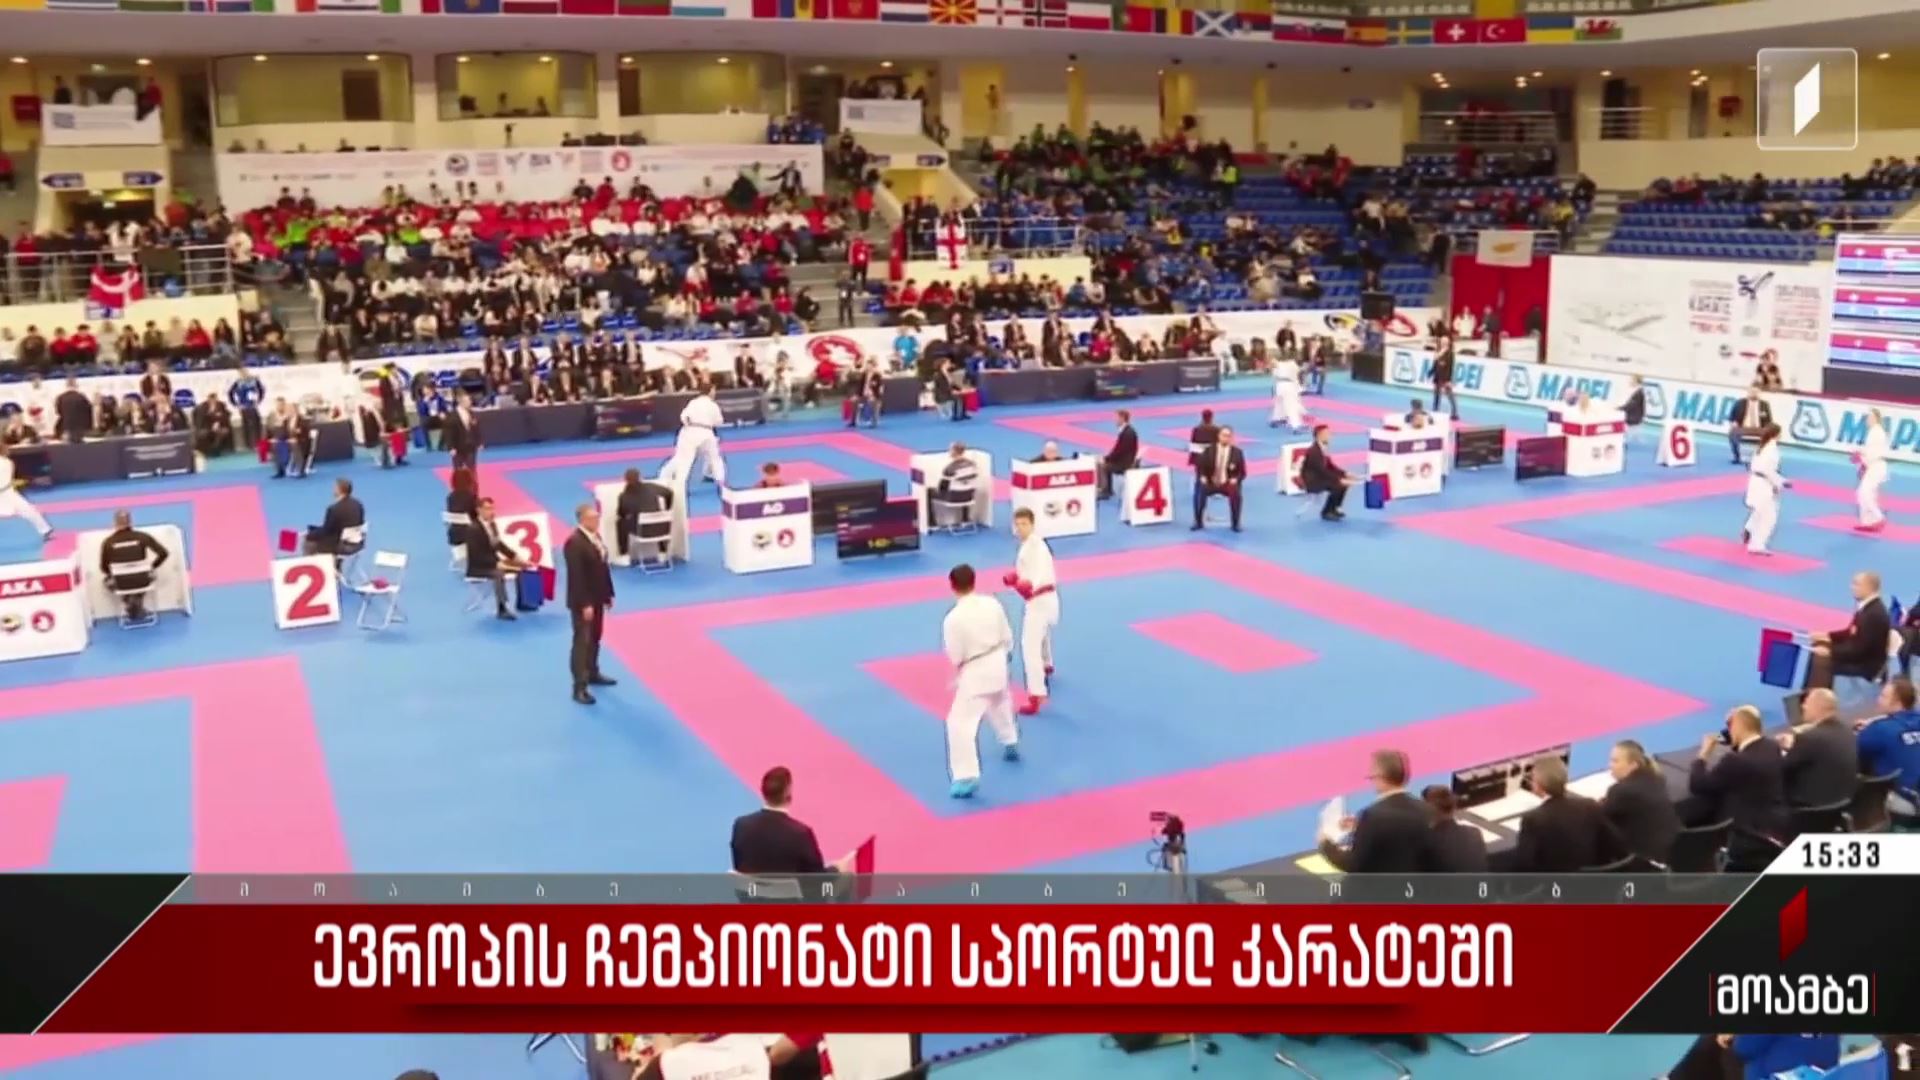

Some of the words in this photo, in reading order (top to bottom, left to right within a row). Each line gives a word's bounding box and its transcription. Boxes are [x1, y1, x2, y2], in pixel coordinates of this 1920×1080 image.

[1418, 358, 1485, 391] MPEI
[1670, 425, 1691, 460] 6
[1048, 473, 1077, 487] AKA
[1135, 472, 1168, 516] 4
[504, 520, 543, 566] 3
[1, 579, 45, 597] AKA
[283, 564, 331, 621] 2
